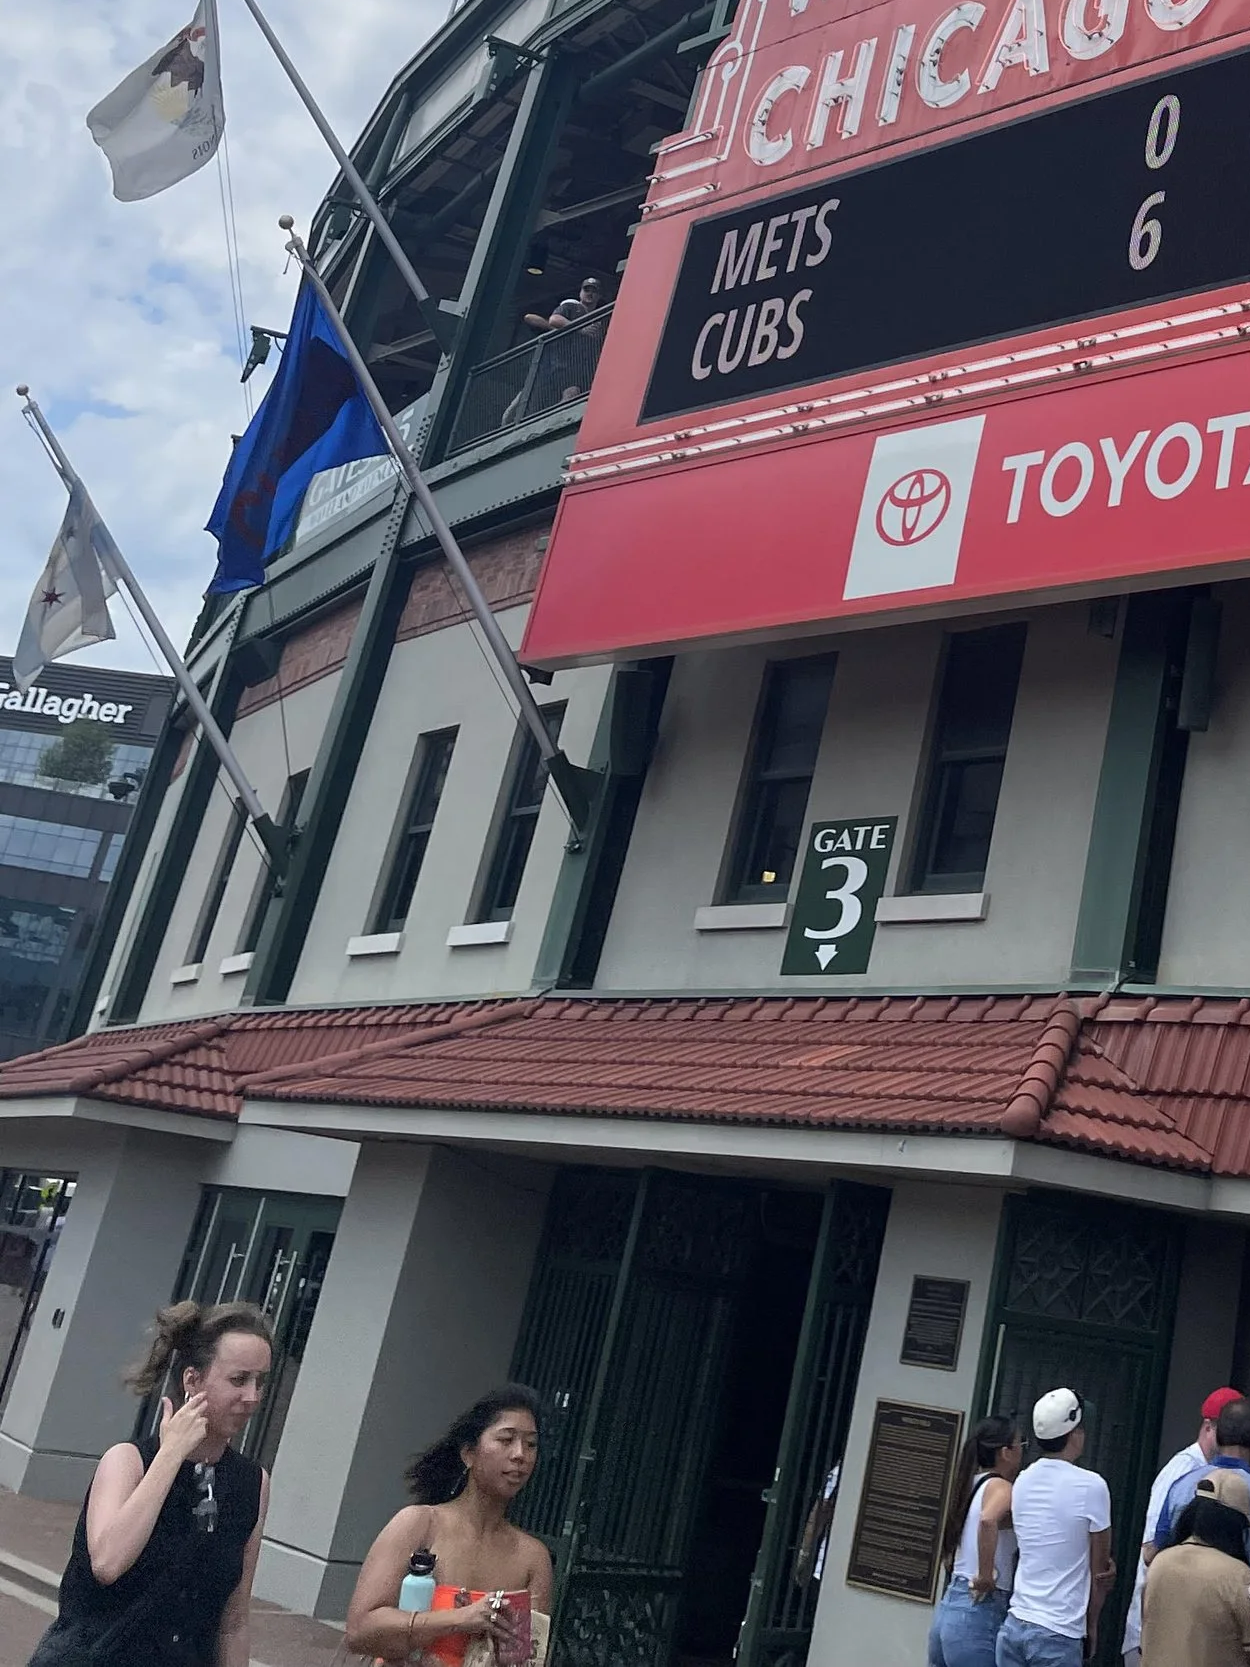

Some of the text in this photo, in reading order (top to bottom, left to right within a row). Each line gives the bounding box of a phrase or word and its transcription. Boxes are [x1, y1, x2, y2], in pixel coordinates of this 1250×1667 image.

[710, 94, 1181, 294] METS 0
[691, 190, 1166, 380] CUBS 6
[804, 856, 868, 940] 3
[814, 825, 890, 853] GATE
